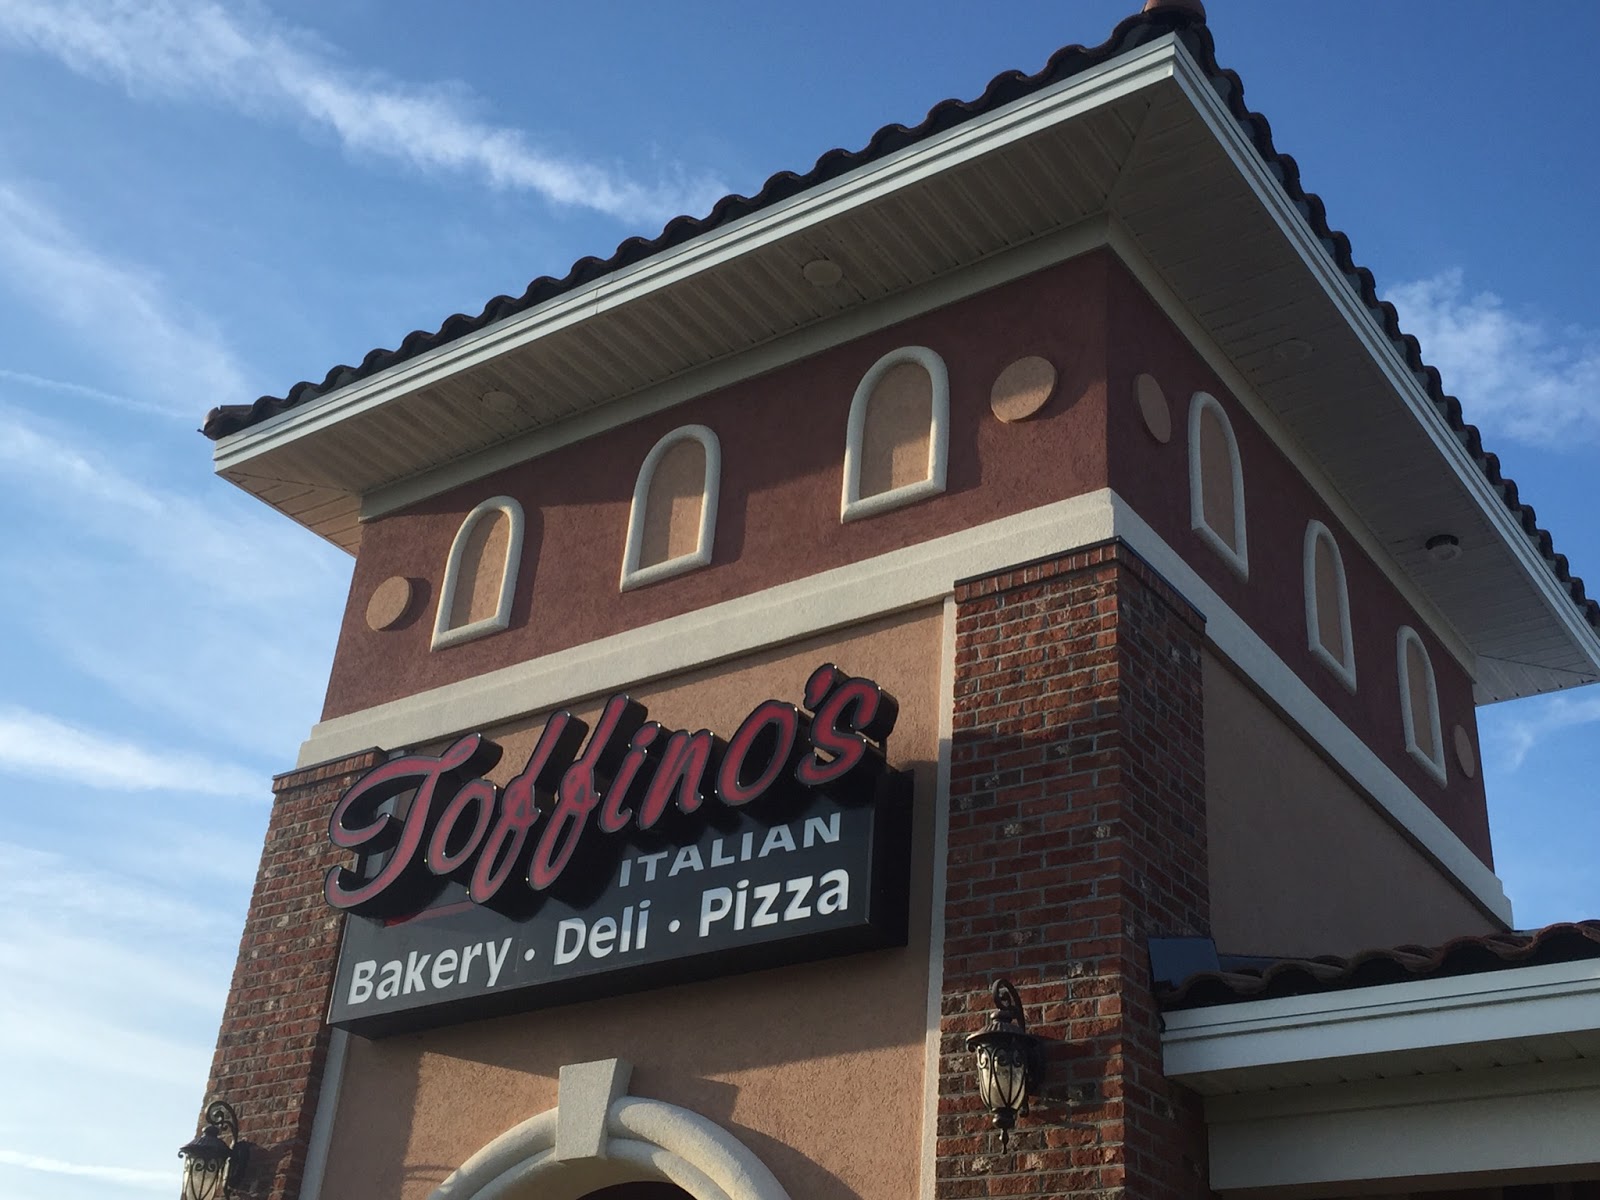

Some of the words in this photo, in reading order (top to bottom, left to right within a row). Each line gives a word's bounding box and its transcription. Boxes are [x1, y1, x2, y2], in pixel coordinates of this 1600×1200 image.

[324, 663, 882, 906] Toffino's
[619, 813, 842, 887] ITALIAN
[348, 937, 512, 1005] Bakery
[553, 901, 650, 965] Deli
[699, 868, 850, 937] Pizza
